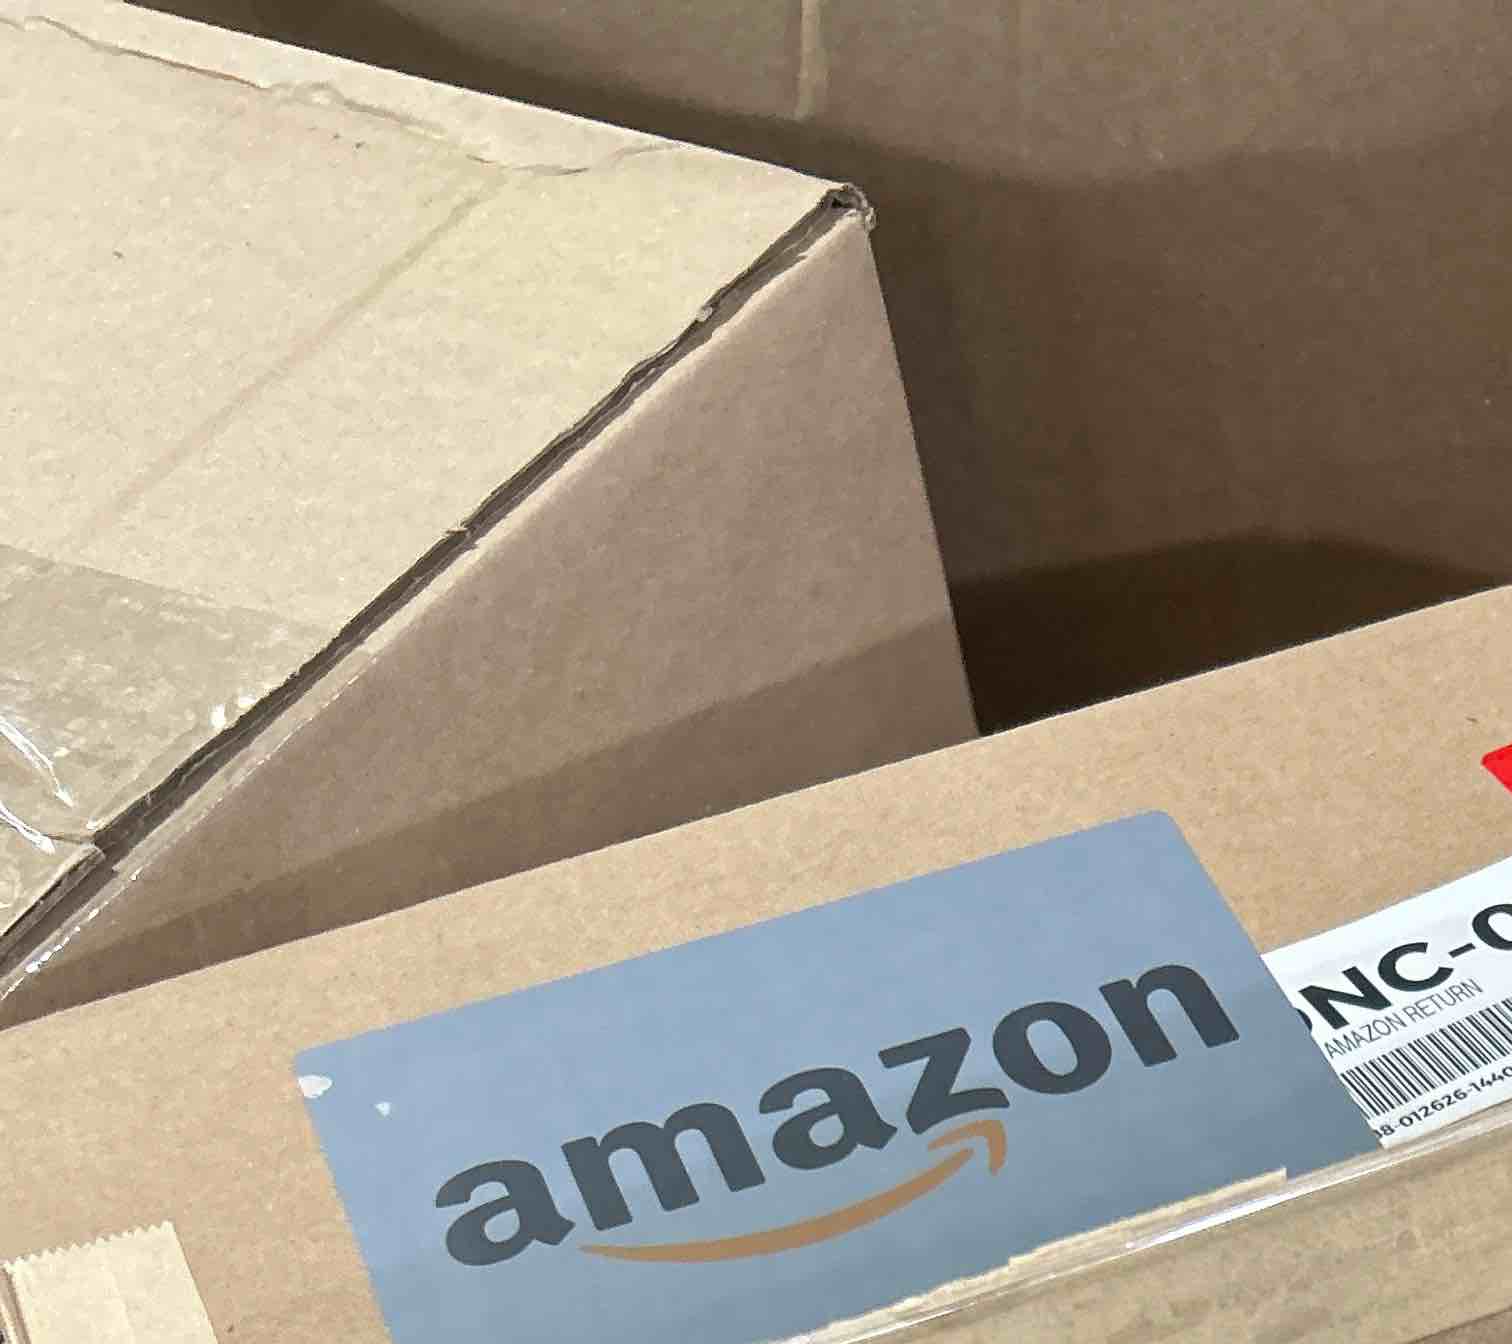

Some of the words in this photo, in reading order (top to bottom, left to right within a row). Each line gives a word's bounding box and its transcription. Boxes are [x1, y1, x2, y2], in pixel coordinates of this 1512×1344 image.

[1323, 1012, 1407, 1059] AMAZON
[1402, 978, 1483, 1023] RETURN
[435, 963, 1241, 1267] amazon
